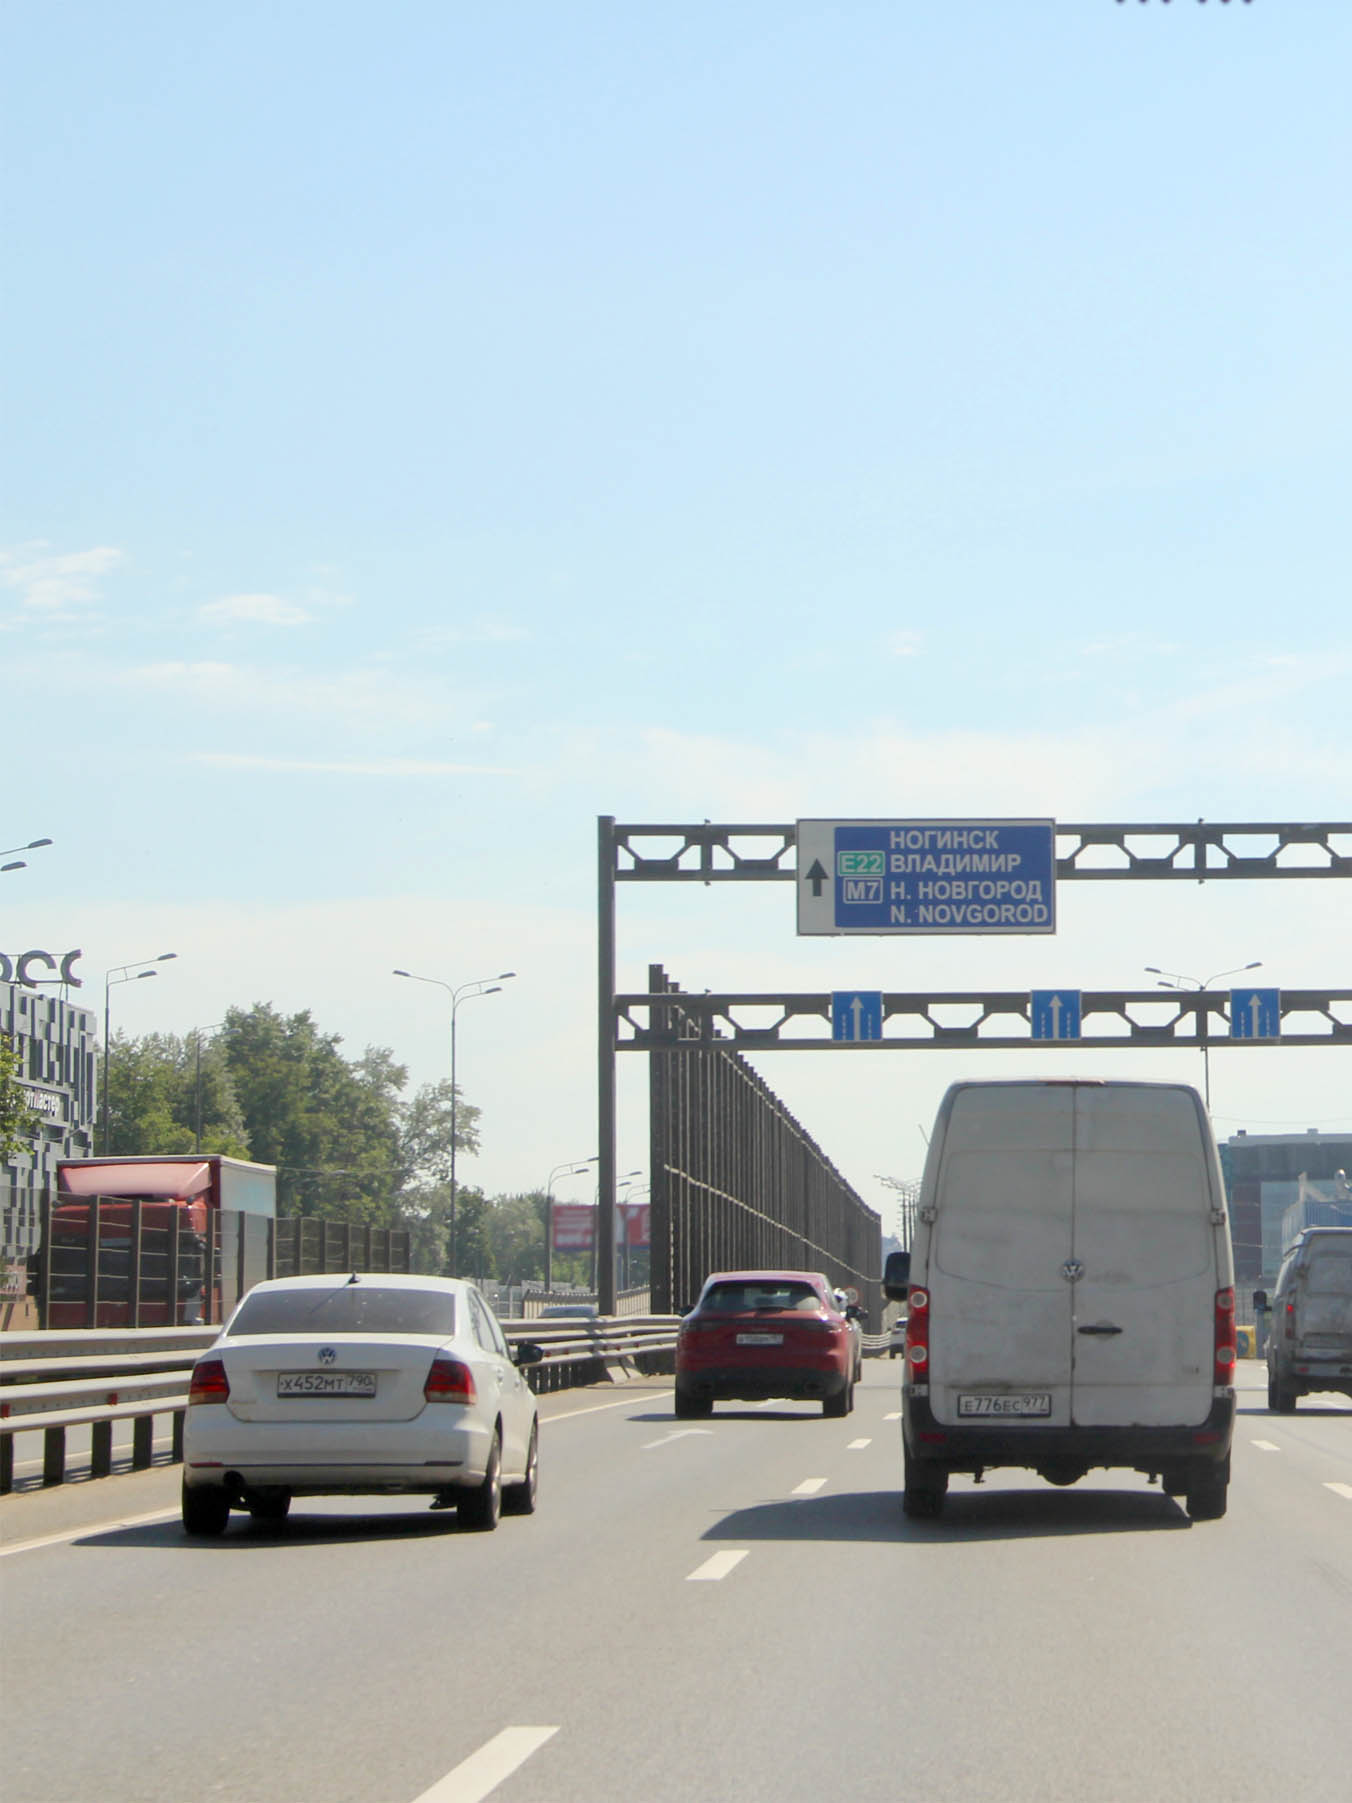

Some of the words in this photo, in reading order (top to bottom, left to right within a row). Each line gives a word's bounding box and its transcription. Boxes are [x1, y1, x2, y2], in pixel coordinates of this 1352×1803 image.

[890, 830, 999, 849] НОГИНСК
[841, 855, 882, 873] E22
[890, 854, 1021, 875] ВЛАДИМИР
[890, 881, 911, 899] Н.
[918, 880, 1043, 902] НОВГОРОД
[890, 906, 911, 923] N.
[918, 904, 1049, 923] NOVGOROD
